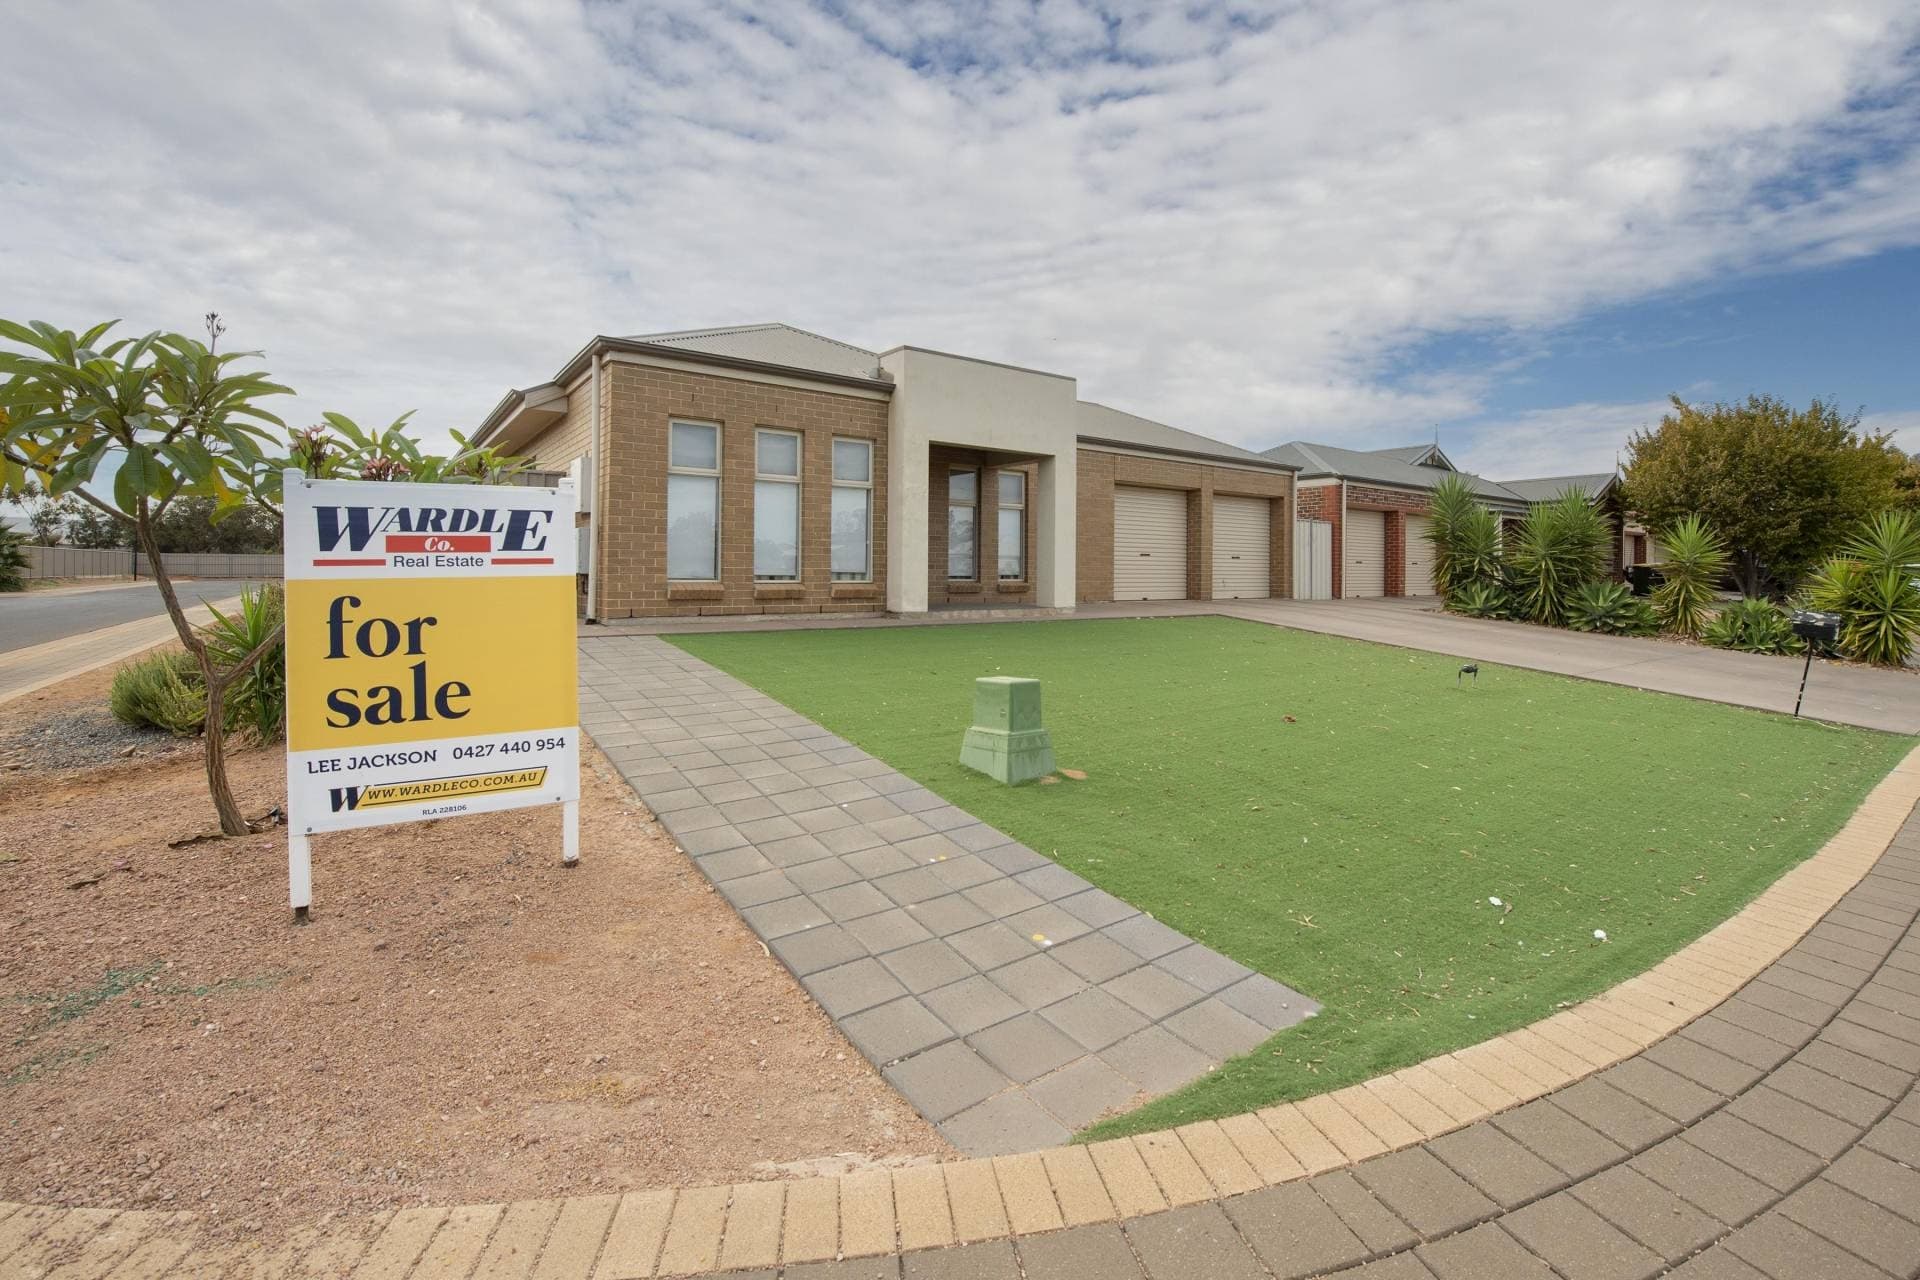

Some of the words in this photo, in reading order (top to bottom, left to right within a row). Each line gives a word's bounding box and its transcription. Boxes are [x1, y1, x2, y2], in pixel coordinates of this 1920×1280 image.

[312, 506, 553, 552] WARDLE
[424, 537, 454, 552] Co.
[394, 555, 429, 567] Real
[435, 555, 484, 567] Estate
[323, 596, 438, 659] for
[326, 660, 471, 729] sale
[307, 759, 342, 775] LEE
[347, 750, 437, 771] JACKSON
[452, 744, 495, 760] 0427
[500, 740, 531, 756] 440
[536, 737, 566, 752] 954
[328, 772, 538, 812] WWW.WARDLECO.COM.AU
[422, 807, 438, 816] RLA
[439, 804, 467, 814] 228106
